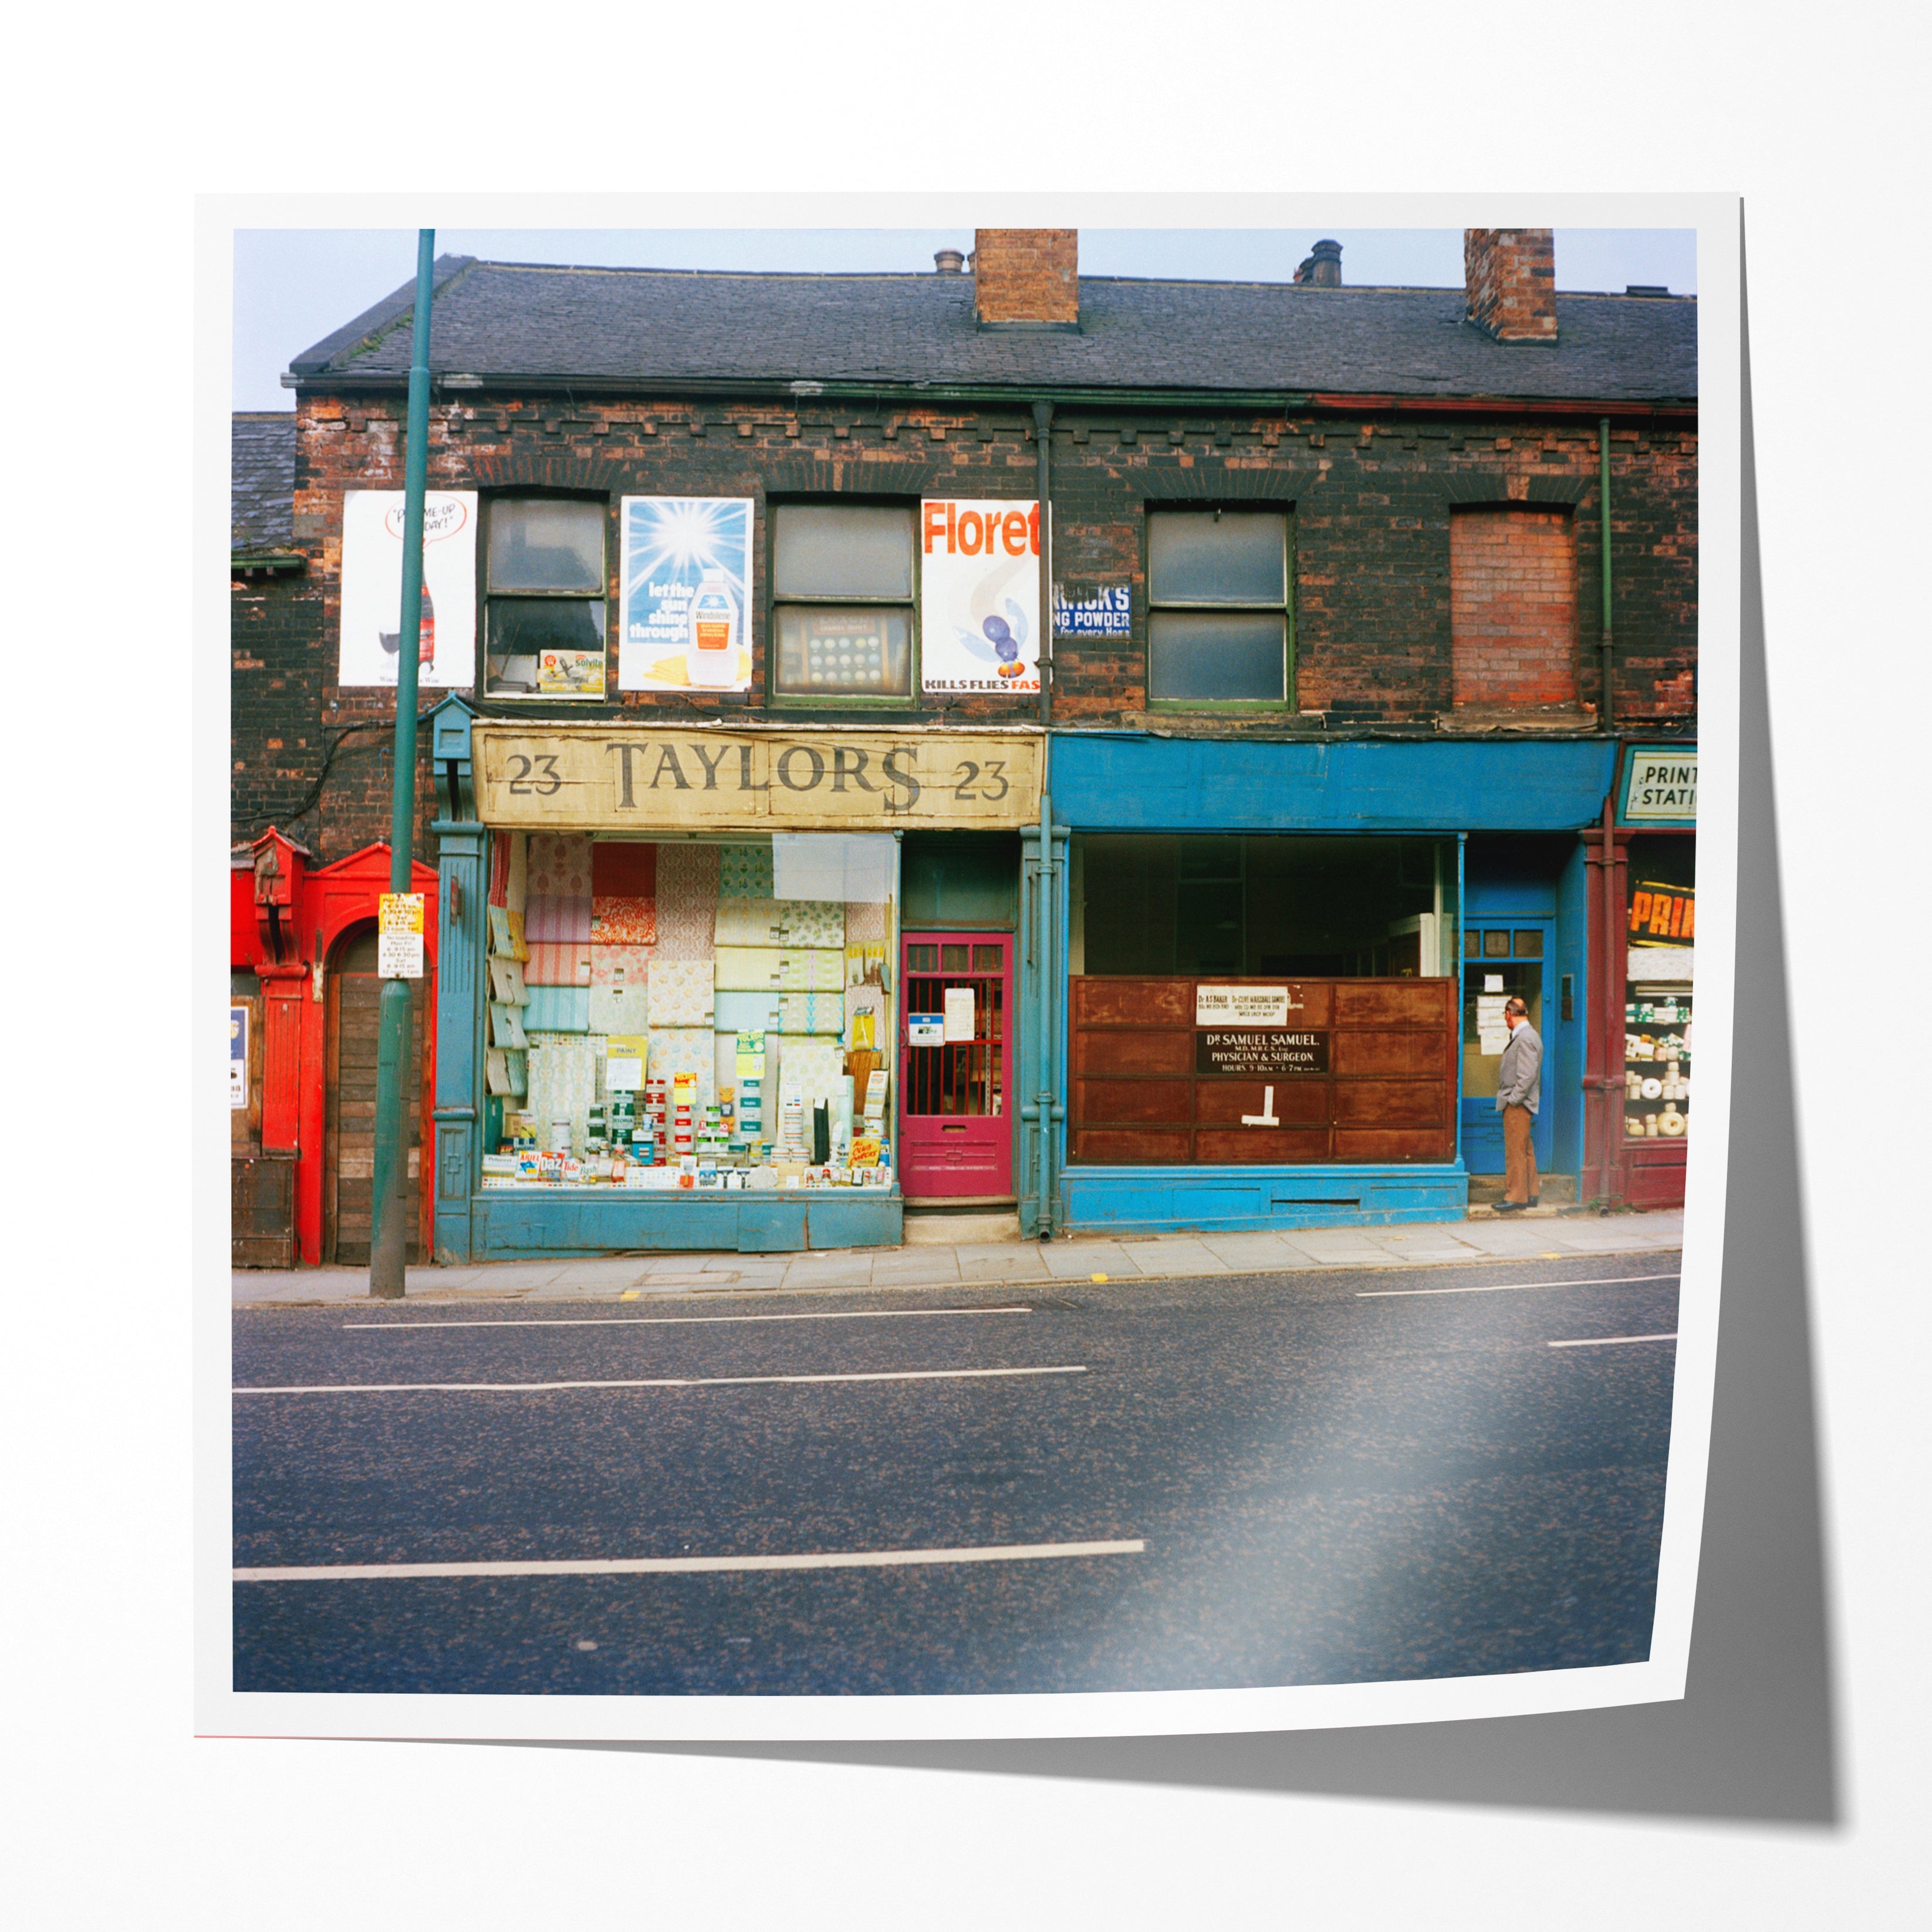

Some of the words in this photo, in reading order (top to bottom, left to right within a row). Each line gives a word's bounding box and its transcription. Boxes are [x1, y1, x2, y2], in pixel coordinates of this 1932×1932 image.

[924, 502, 1040, 556] Floret
[648, 582, 668, 597] let
[669, 582, 695, 597] the
[661, 599, 687, 612] sun
[648, 609, 688, 625] shine
[695, 611, 731, 620] Windolene
[1074, 612, 1130, 627] POWDER
[629, 623, 688, 642] through
[575, 658, 603, 667] solvite
[925, 680, 967, 690] KILLS
[970, 680, 1009, 690] FLIES
[1011, 680, 1041, 690] FAS
[508, 754, 562, 795] 23
[606, 742, 919, 812] TAYLORS
[954, 760, 1009, 801] 23
[1642, 789, 1697, 805] STATI
[1222, 1035, 1268, 1045] SAMUEL
[1212, 1052, 1259, 1062] PHYSICIAN
[1261, 1053, 1269, 1062] &
[541, 1156, 562, 1171] Daz
[564, 1161, 579, 1171] Tide
